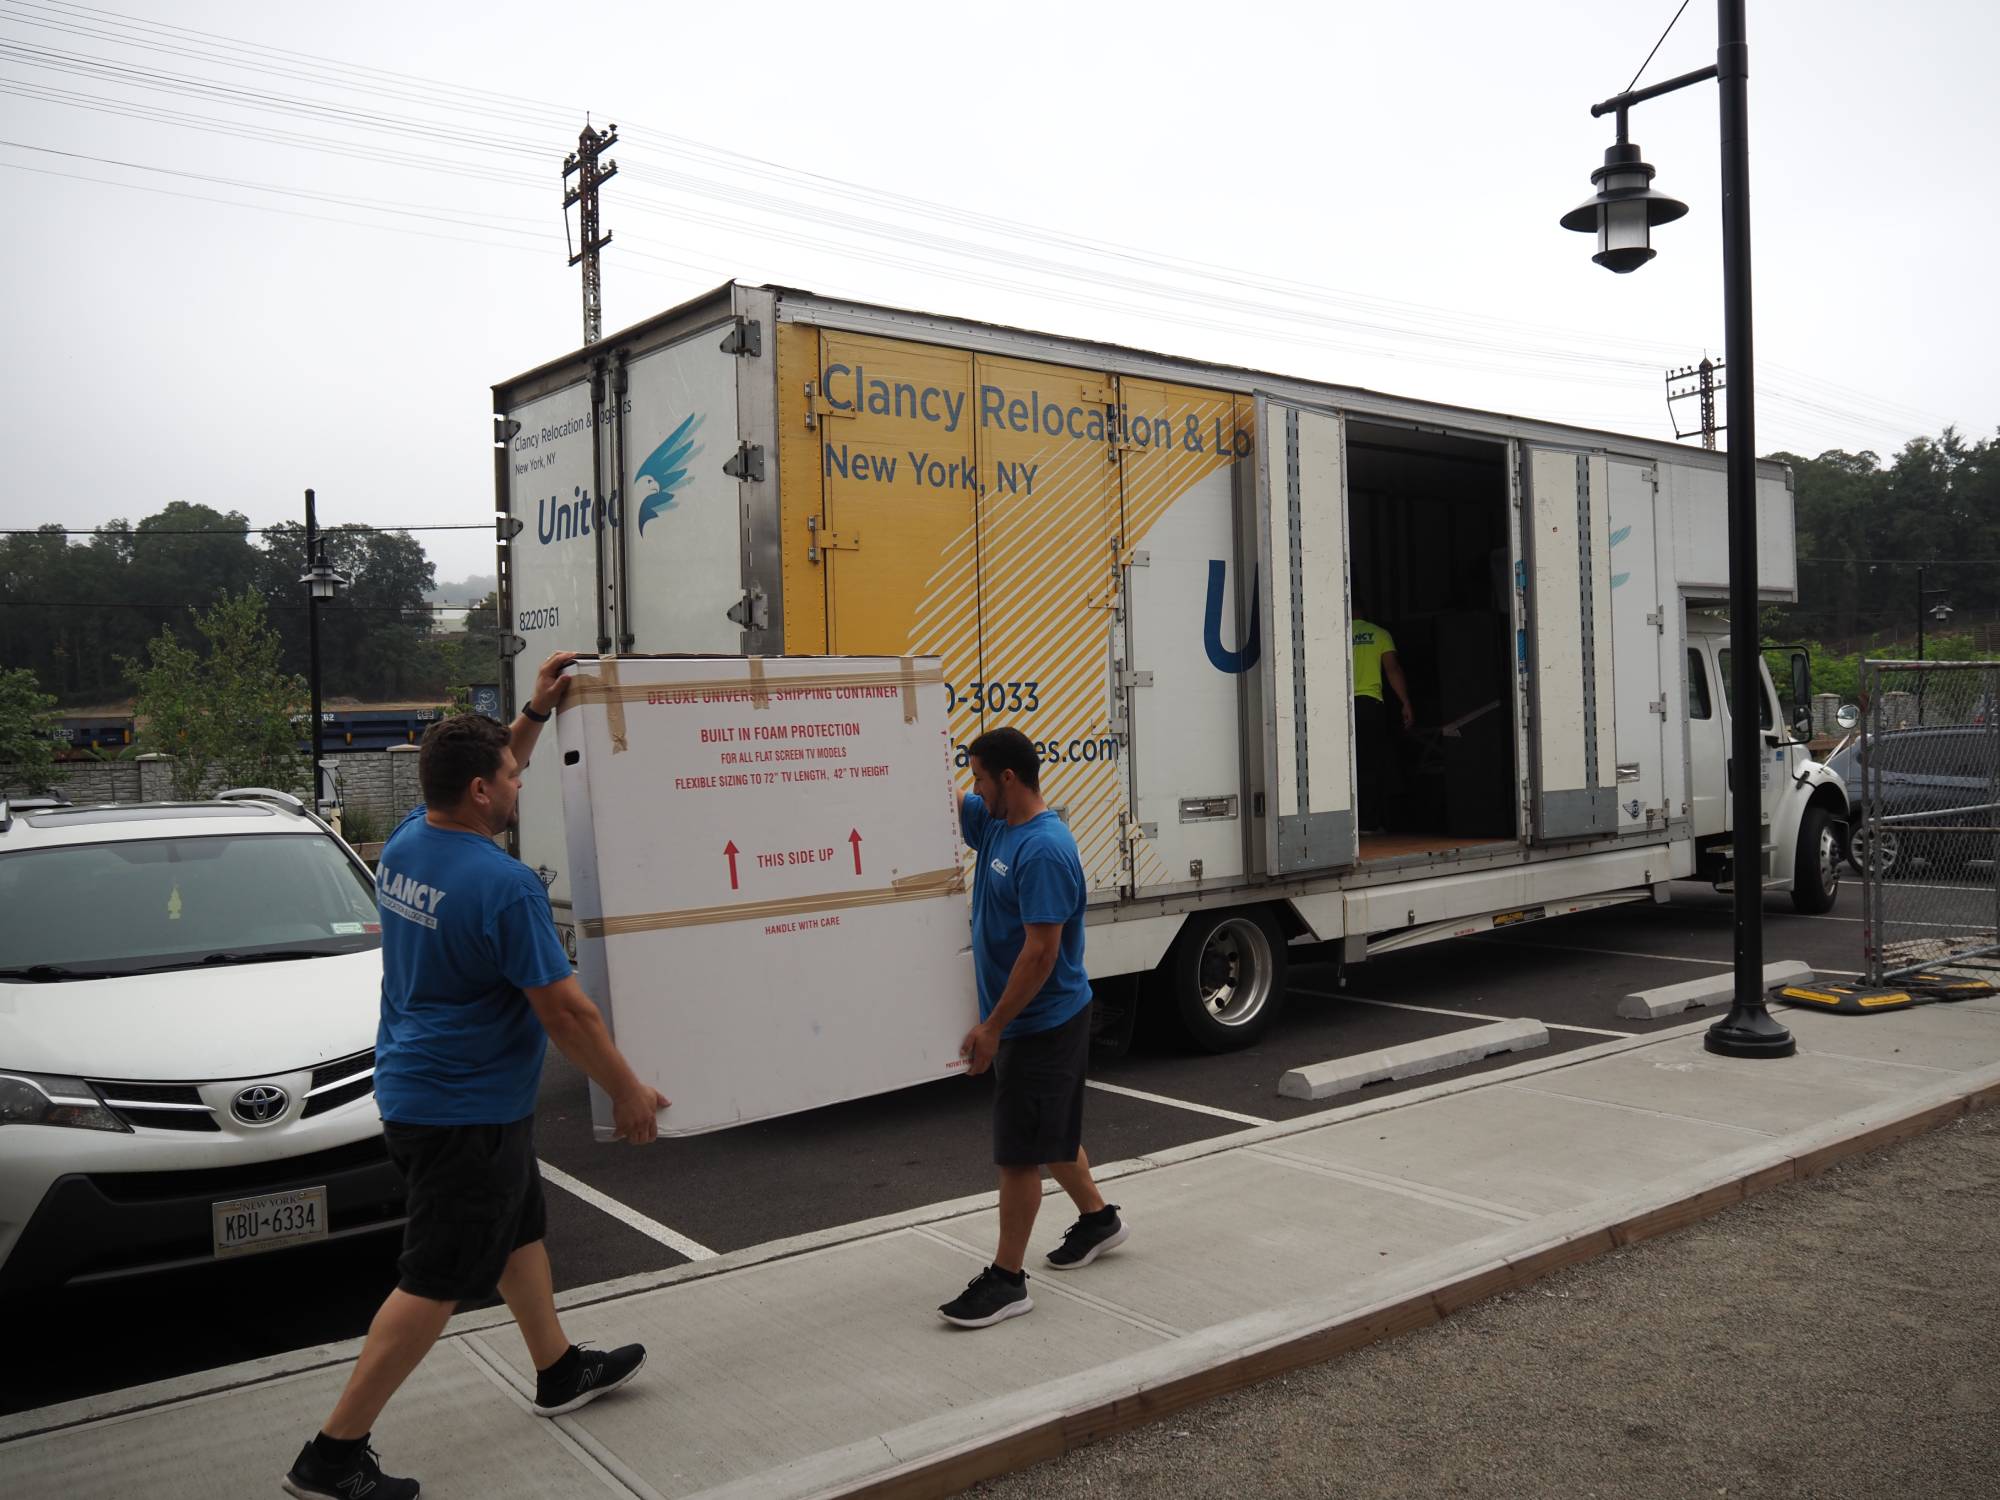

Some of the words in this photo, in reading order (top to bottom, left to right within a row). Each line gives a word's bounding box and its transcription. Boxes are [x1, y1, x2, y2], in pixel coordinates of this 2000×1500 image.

[822, 363, 965, 432] Clancy
[1183, 413, 1204, 453] &
[1215, 416, 1255, 459] Lo
[514, 430, 540, 452] Clancy
[541, 417, 584, 443] Relocation
[586, 412, 592, 428] &
[515, 462, 528, 477] New
[530, 456, 545, 471] York,
[547, 452, 556, 467] NY
[825, 442, 897, 483] New
[908, 451, 985, 496] York,
[997, 460, 1038, 496] NY
[519, 606, 560, 632] 8220761
[647, 689, 699, 705] DELUXE
[776, 686, 832, 702] SHIPPING
[836, 685, 899, 700] CONTAINER
[701, 727, 735, 743] BUILT
[738, 727, 751, 741] IN
[754, 725, 788, 741] FOAM
[791, 722, 861, 739] PROTECTION
[721, 752, 737, 765] FOR
[739, 751, 753, 763] ALL
[755, 750, 773, 762] FLAT
[775, 749, 804, 761] SCREEN
[806, 748, 816, 759] TV
[817, 747, 847, 759] MODELS
[675, 776, 717, 790] FLEXIBLE
[719, 774, 748, 787] SIZING
[750, 773, 762, 785] TO
[764, 772, 779, 784] 72"
[781, 771, 792, 782] TV
[794, 769, 829, 782] LENGTH,
[833, 767, 847, 779] 42"
[849, 767, 859, 778] TV
[861, 765, 889, 777] HEIGHT
[757, 855, 785, 868] THIS
[788, 850, 815, 865] SIDE
[818, 848, 834, 862] UP
[765, 922, 796, 935] HANDLE
[799, 919, 819, 931] WITH
[820, 916, 840, 928] CARE
[243, 1201, 267, 1212] NEW
[270, 1196, 298, 1207] YORK
